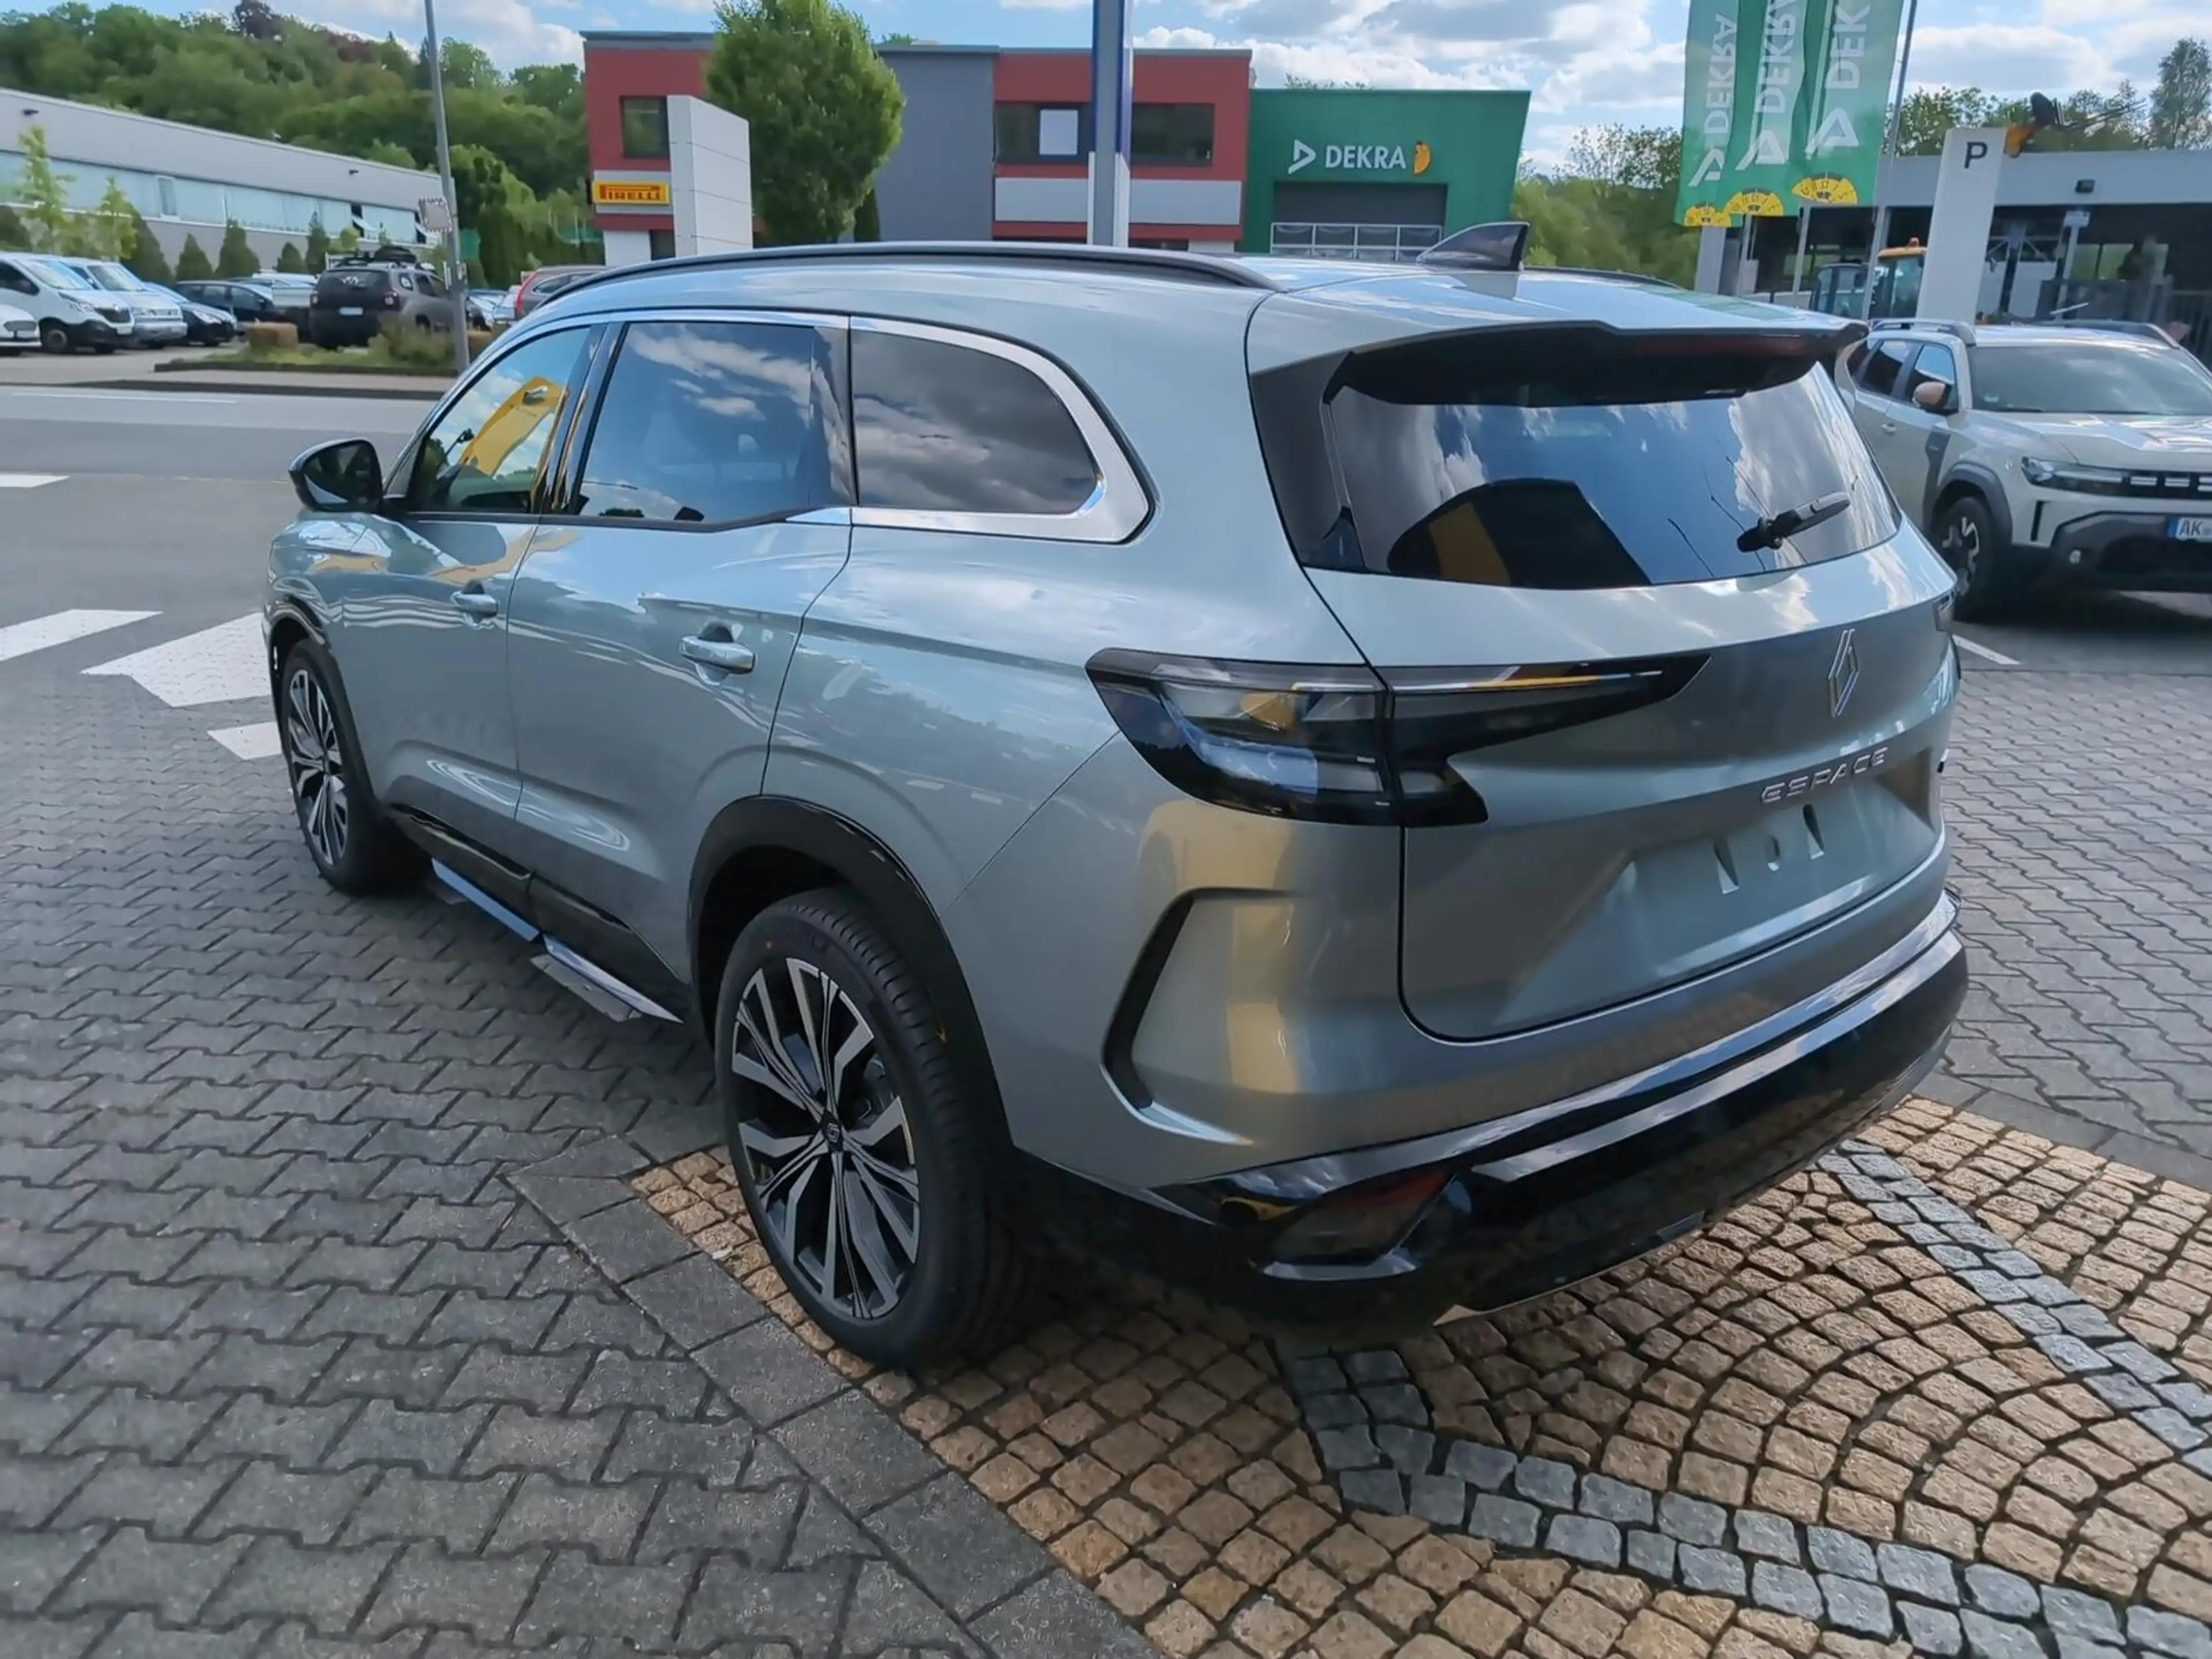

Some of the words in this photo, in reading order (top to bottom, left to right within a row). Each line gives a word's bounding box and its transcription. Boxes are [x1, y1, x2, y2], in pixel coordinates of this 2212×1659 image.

[1326, 146, 1406, 169] DEKRA
[1964, 142, 1987, 169] P
[599, 184, 660, 199] PIRELLI
[1762, 747, 1888, 803] ESPACE
